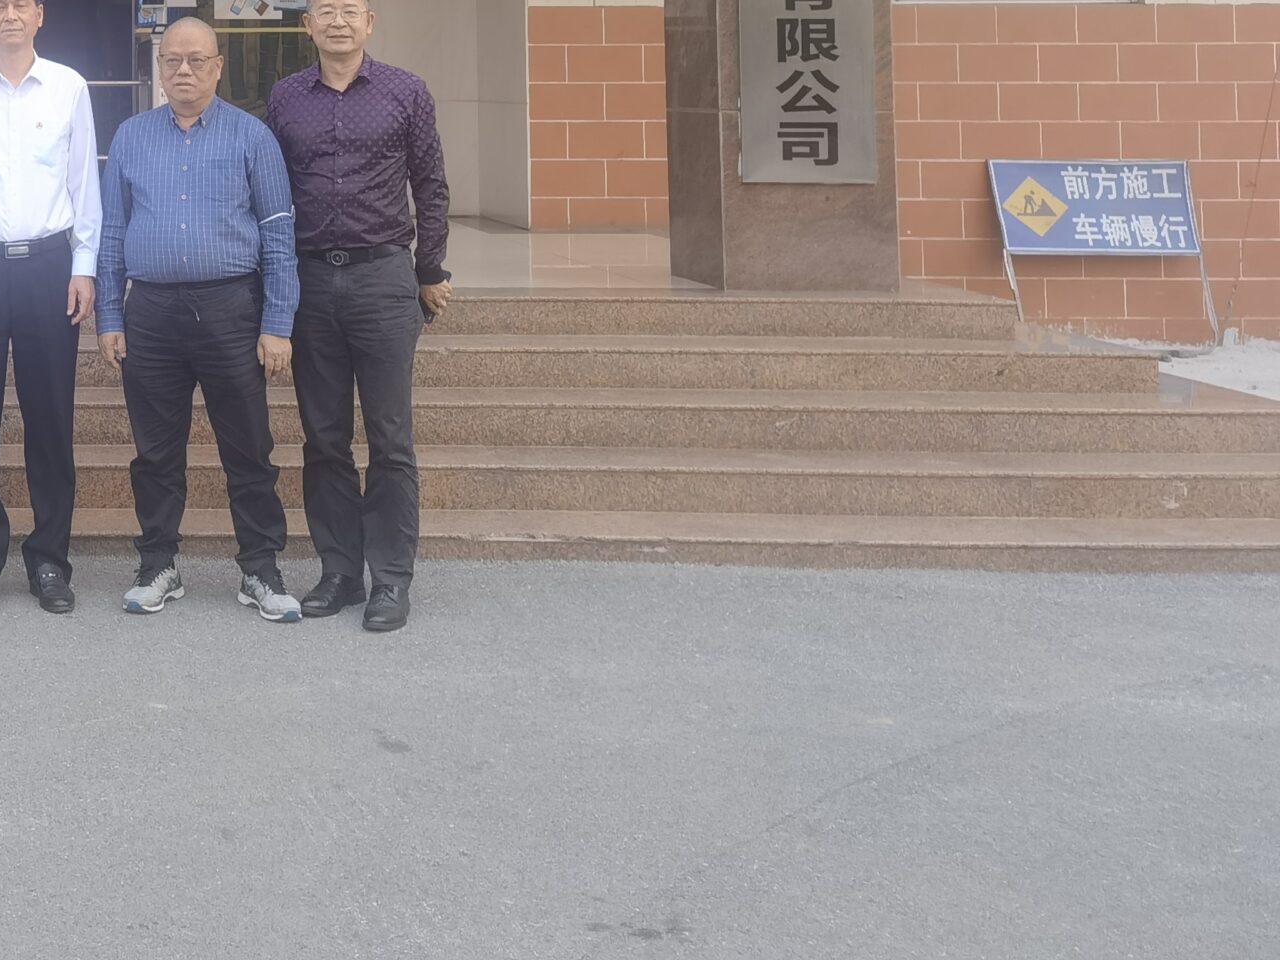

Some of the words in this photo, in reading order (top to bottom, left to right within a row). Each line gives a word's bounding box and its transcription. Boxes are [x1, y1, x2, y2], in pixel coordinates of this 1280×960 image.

[1061, 165, 1182, 200] 前方施工
[1072, 213, 1188, 248] 车辆慢行
